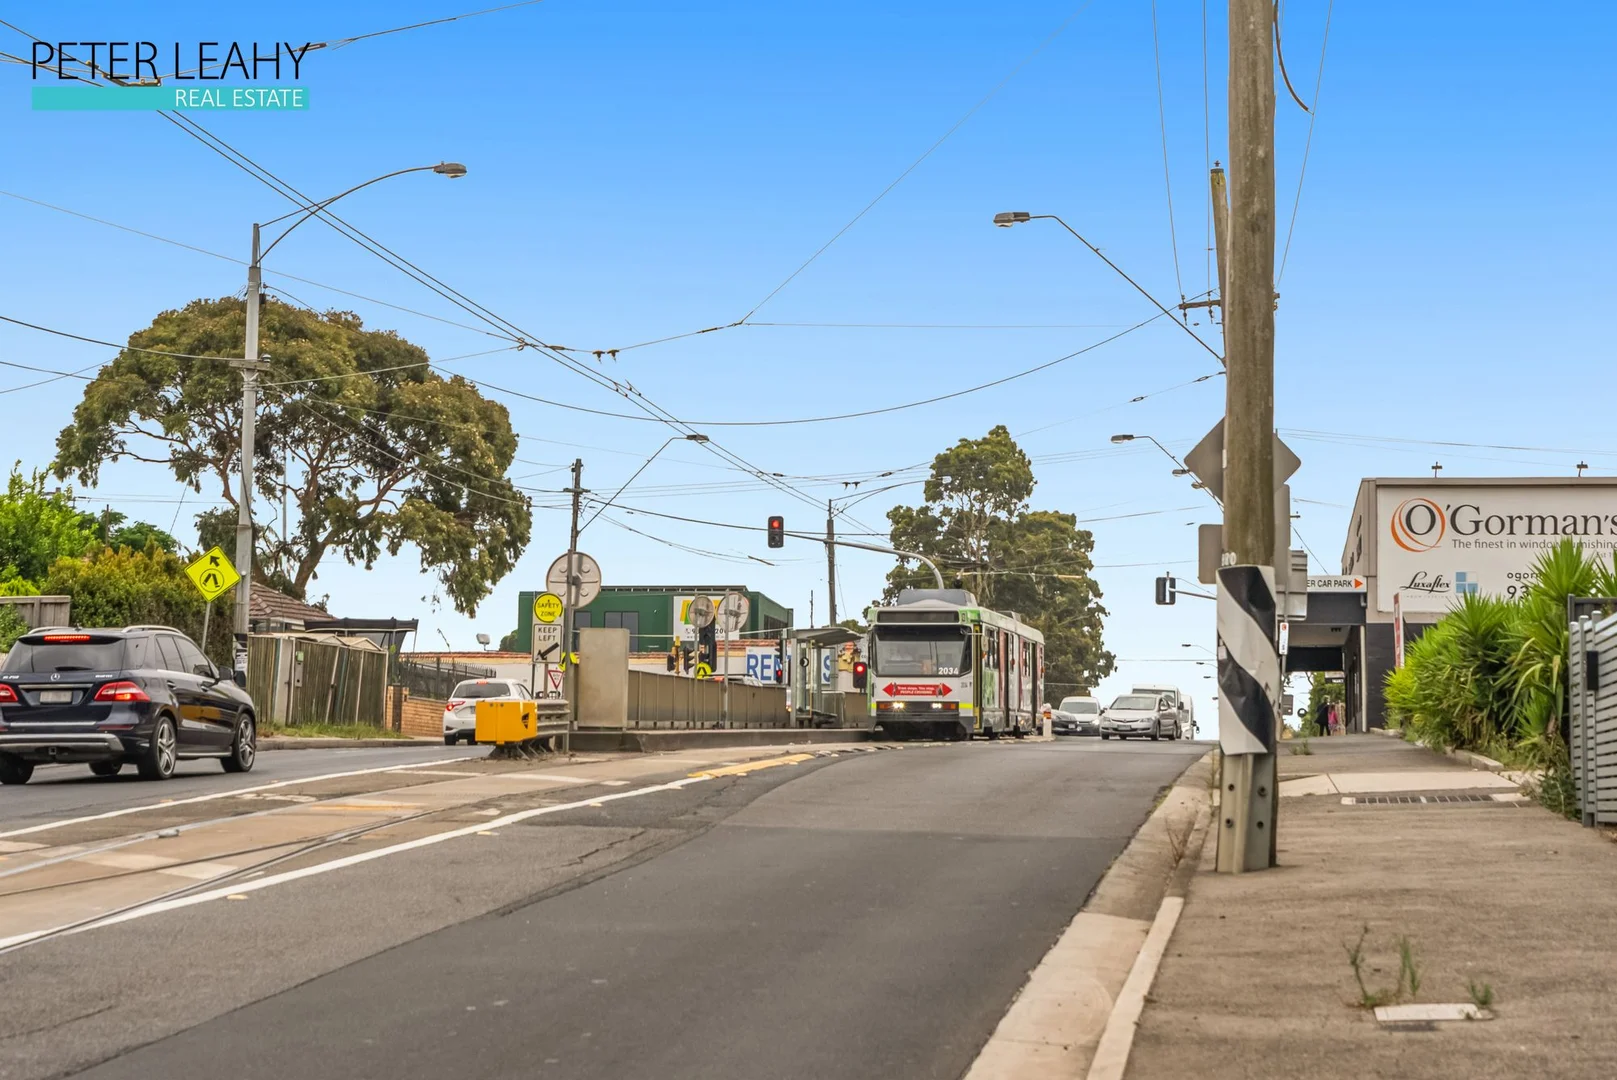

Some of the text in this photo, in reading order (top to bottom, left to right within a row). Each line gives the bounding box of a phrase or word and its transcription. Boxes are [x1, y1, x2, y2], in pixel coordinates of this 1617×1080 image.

[1452, 539, 1471, 549] The
[1474, 538, 1503, 549] finest
[1507, 539, 1516, 549] in
[1317, 579, 1332, 588] CAR
[1333, 579, 1353, 588] PARK
[1400, 571, 1451, 594] Luxaflex
[938, 667, 959, 675] 2034
